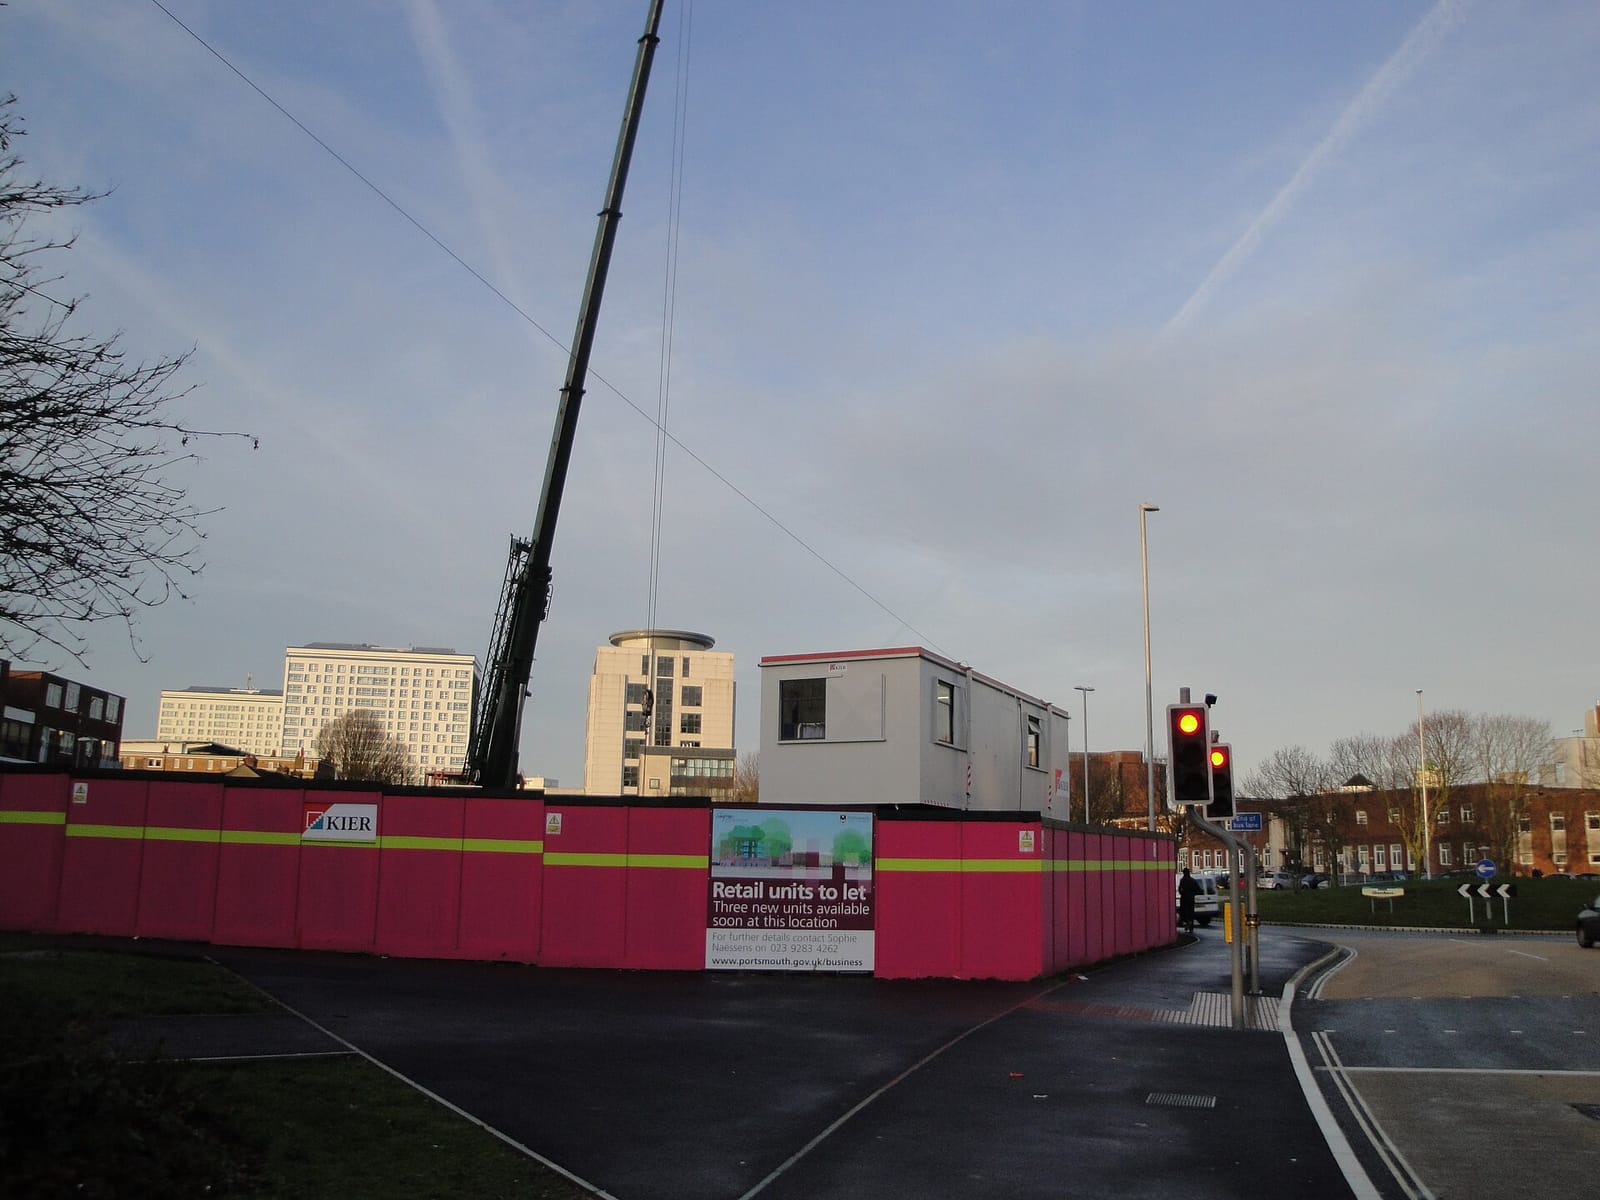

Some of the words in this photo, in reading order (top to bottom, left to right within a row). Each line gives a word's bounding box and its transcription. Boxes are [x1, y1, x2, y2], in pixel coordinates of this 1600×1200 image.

[326, 815, 372, 831] KIER
[712, 881, 764, 898] Retail
[769, 883, 814, 899] units
[818, 884, 838, 900] to
[843, 884, 867, 900] let
[713, 901, 748, 913] Three
[752, 904, 779, 914] new
[783, 902, 813, 914] units
[816, 903, 870, 915] available
[712, 917, 743, 927] soon
[747, 916, 759, 927] at
[764, 915, 785, 927] this
[788, 916, 838, 928] location
[712, 932, 726, 941] For
[729, 932, 759, 941] further
[762, 932, 790, 942] details
[792, 933, 825, 942] contact
[828, 933, 858, 943] Sophie
[712, 943, 753, 952] Naessens
[770, 943, 787, 952] 023
[790, 944, 813, 953] 9283
[817, 944, 838, 953] 4262
[712, 957, 864, 967] www.portsmouth.gov.uk/business
